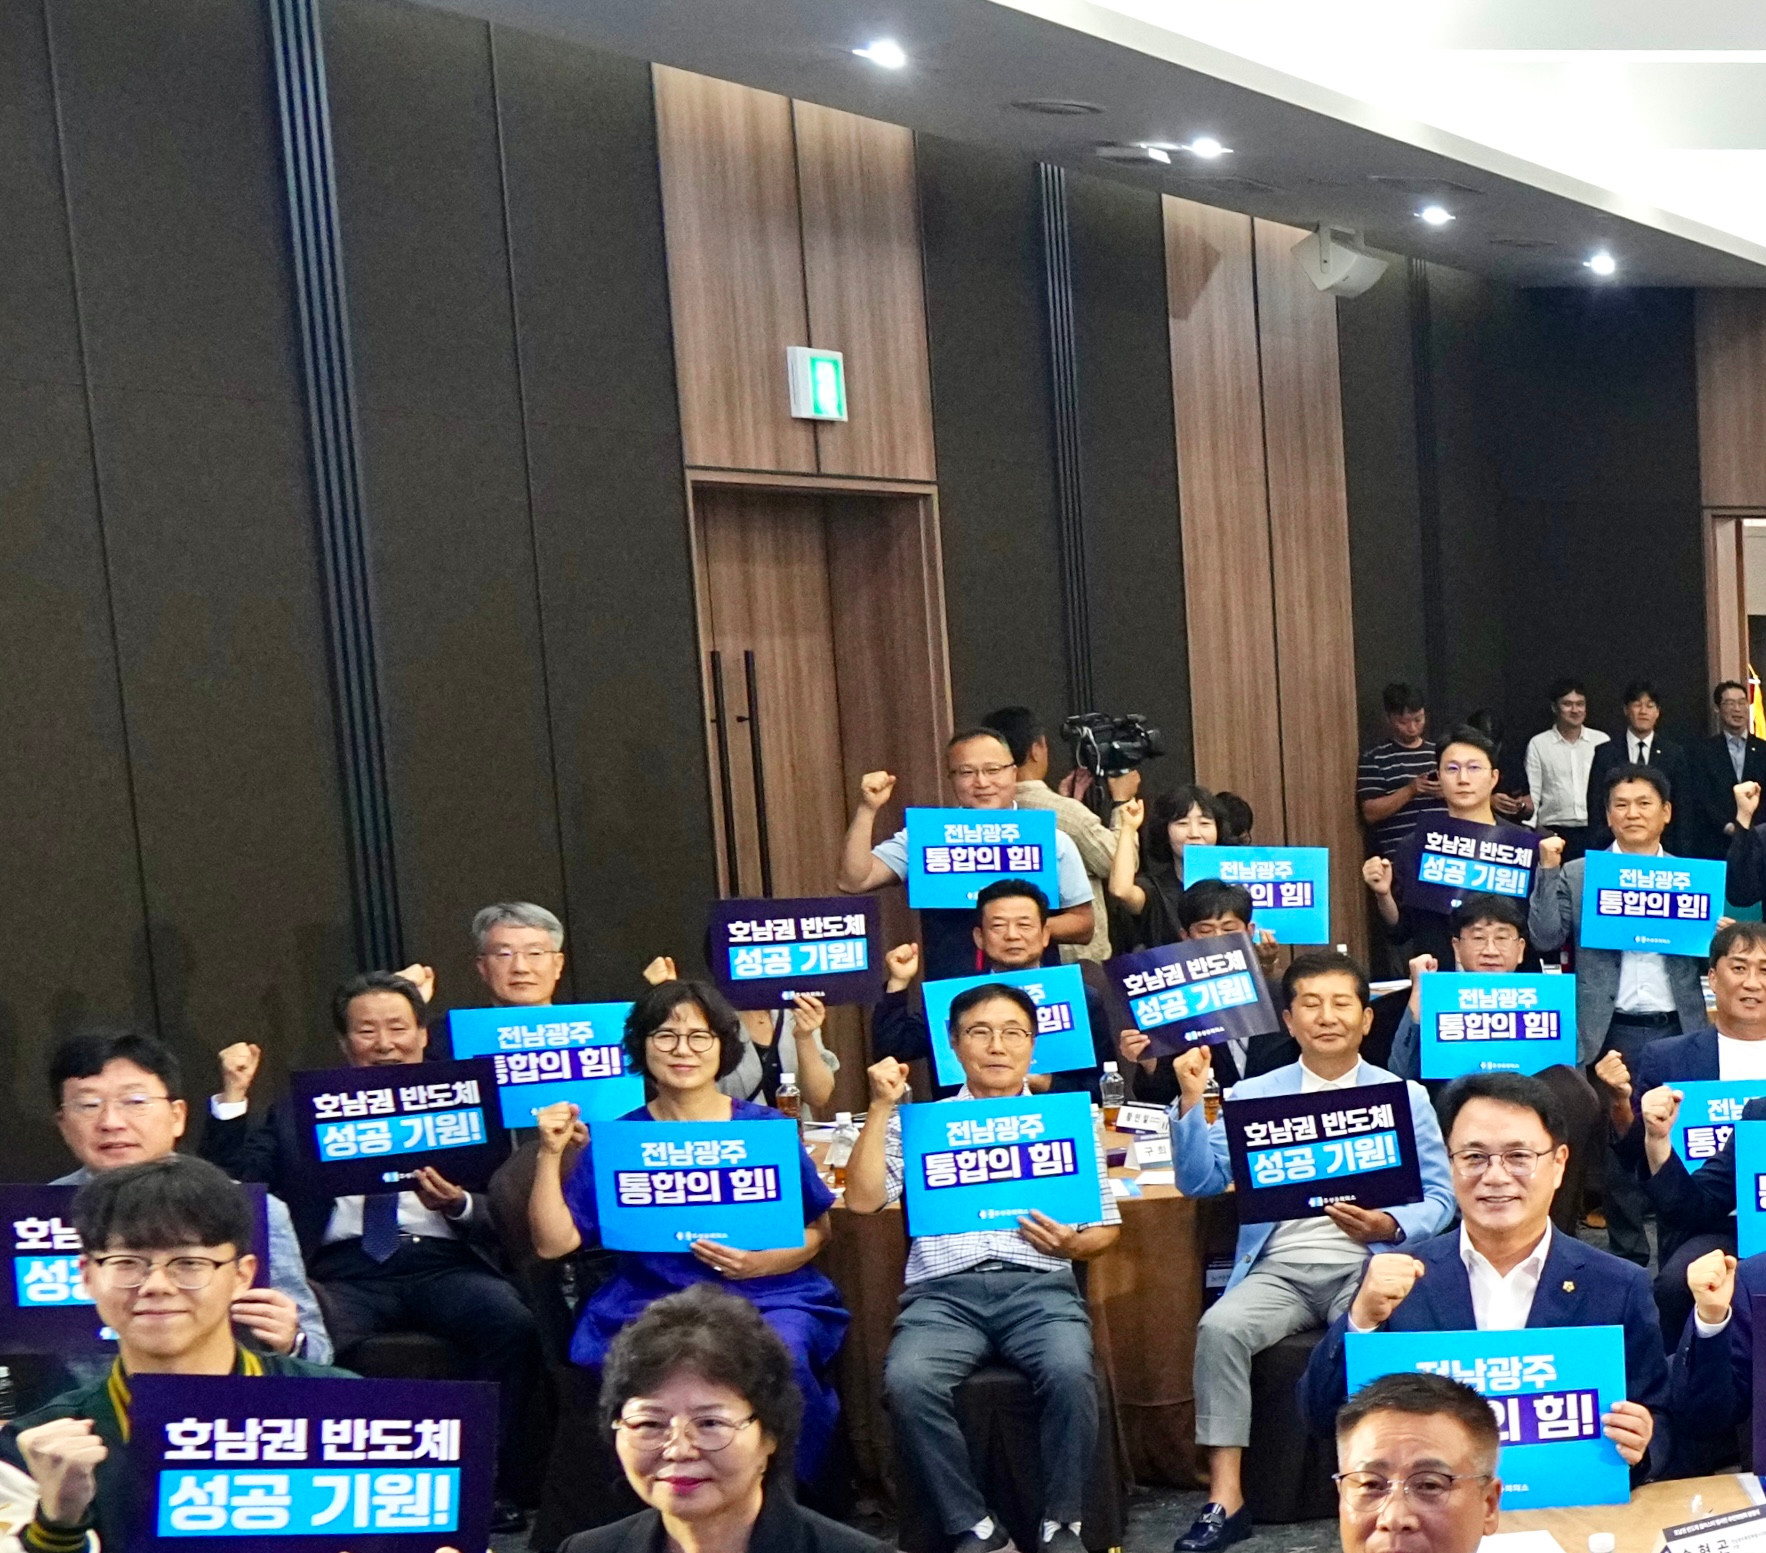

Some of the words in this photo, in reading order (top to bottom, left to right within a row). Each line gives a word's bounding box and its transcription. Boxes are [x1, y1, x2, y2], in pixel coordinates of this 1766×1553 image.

[945, 824, 1019, 843] 전남광주
[1425, 832, 1476, 858] 호남권
[1476, 841, 1532, 870] 반도체
[926, 847, 1000, 872] 통합의
[1007, 847, 1039, 870] 힘!
[1424, 857, 1466, 884] 성공
[1472, 864, 1526, 894] 기원!
[1620, 869, 1690, 890] 전남광주
[1600, 890, 1670, 917] 통합의
[1677, 894, 1707, 918] 힘!
[728, 919, 796, 942] 호남권
[801, 914, 865, 939] 반도체
[735, 947, 791, 976] 성공
[800, 942, 864, 970] 기원!
[1123, 963, 1186, 1003] 호남권
[1186, 950, 1247, 980] 반도체
[1137, 990, 1189, 1026] 성공
[1192, 976, 1253, 1010] 기원!
[1459, 989, 1537, 1009] 전남광주
[1439, 1013, 1516, 1040] 통합의
[1524, 1013, 1556, 1038] 힘!
[313, 1089, 395, 1118] 호남권
[400, 1080, 480, 1111] 반도체
[324, 1121, 392, 1156] 성공
[403, 1112, 481, 1147] 기원!
[947, 1114, 1044, 1146] 전남광주
[1244, 1115, 1318, 1146] 호남권
[1321, 1104, 1394, 1137] 반도체
[642, 1140, 747, 1166] 전남광주
[926, 1146, 1021, 1186] 통합의
[1028, 1142, 1073, 1176] 힘!
[1255, 1147, 1316, 1184] 성공
[1323, 1135, 1396, 1173] 기원!
[619, 1171, 721, 1204] 통합의
[729, 1168, 776, 1201] 힘!
[165, 1418, 307, 1460] 호남권
[322, 1419, 460, 1460] 반도체
[170, 1475, 291, 1530] 성공
[312, 1473, 450, 1527] 기원!
